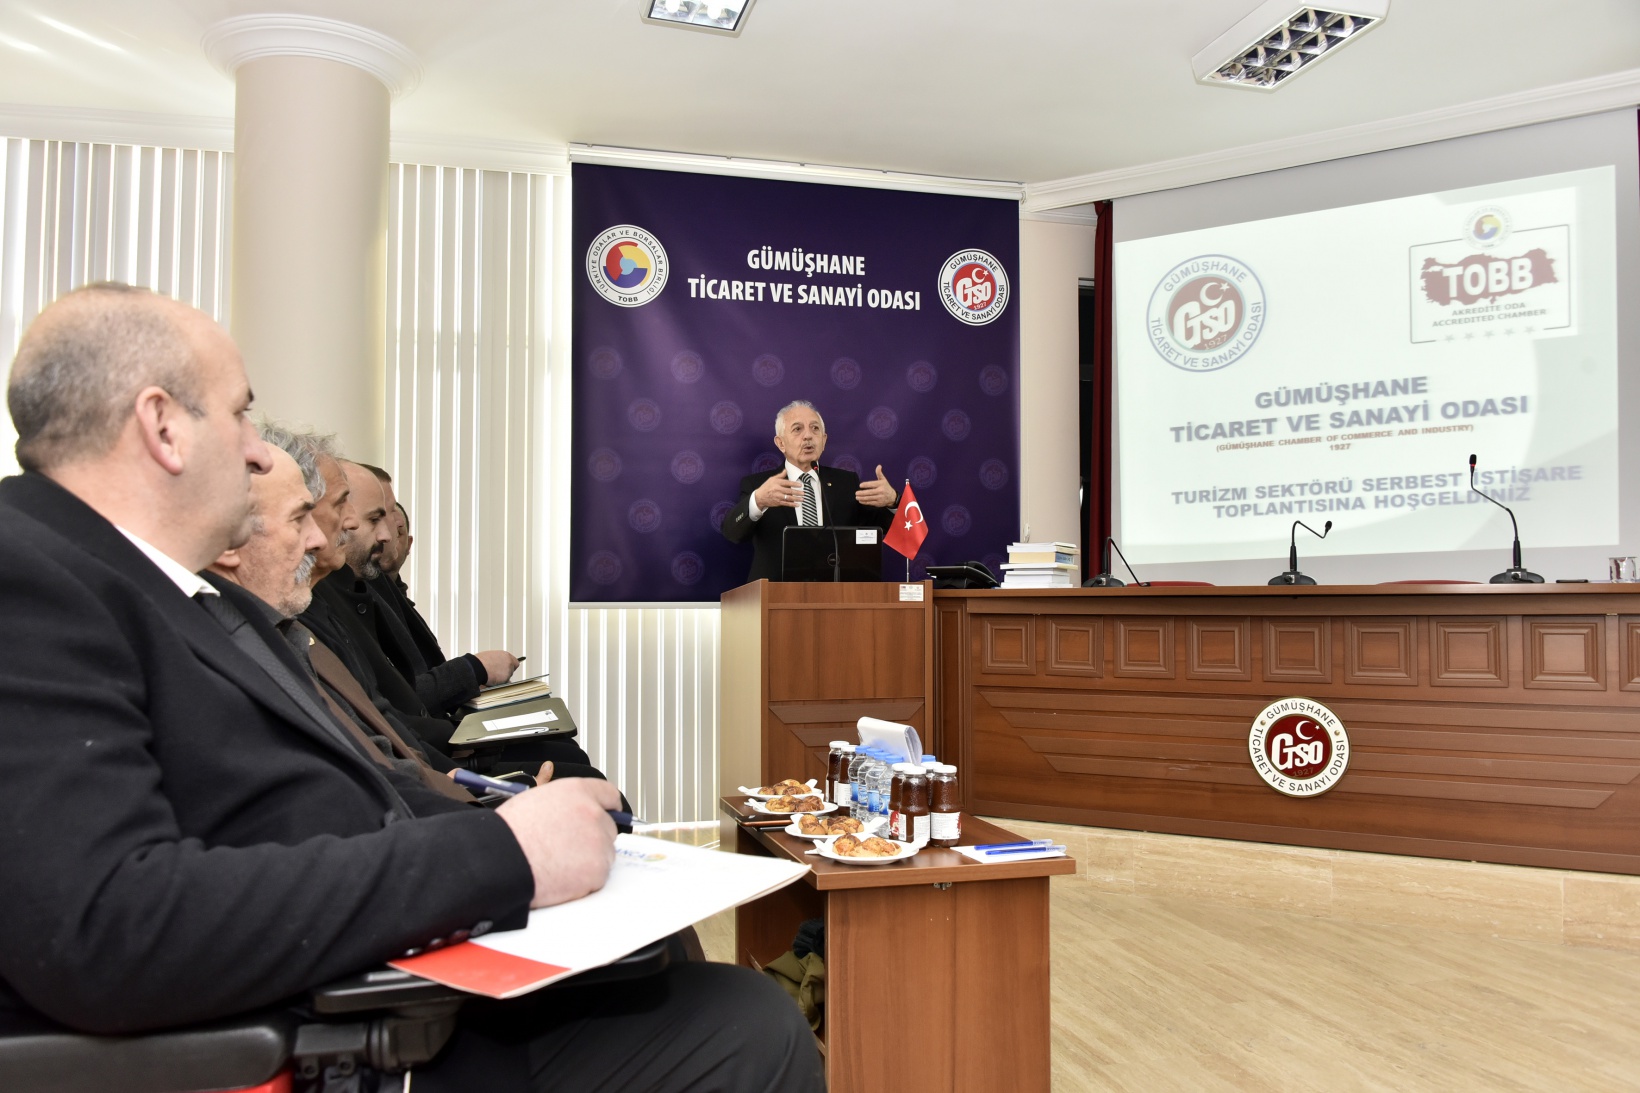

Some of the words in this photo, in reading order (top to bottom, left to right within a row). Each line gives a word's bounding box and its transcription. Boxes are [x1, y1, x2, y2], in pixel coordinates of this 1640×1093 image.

[592, 232, 617, 256] ODALAR
[633, 231, 663, 265] BORSALAR
[747, 245, 866, 277] GÜMÜŞHANE
[949, 253, 999, 273] GÜMÜŞHANE
[687, 274, 766, 302] TİCARET
[769, 283, 793, 303] VE
[797, 283, 863, 307] SANAYİ
[867, 289, 921, 310] ODASI
[1163, 260, 1247, 292] GÜMÜŞHANE
[1442, 257, 1533, 298] TOBB
[961, 309, 970, 319] VE
[994, 284, 1005, 308] ODASI
[973, 301, 987, 310] 1927
[1432, 314, 1495, 327] ACCREDITED
[1497, 308, 1547, 320] CHAMBER
[1504, 302, 1526, 310] ODA
[1151, 317, 1183, 362] TİCARET
[1183, 355, 1199, 367] VE
[1243, 301, 1262, 341] ODASI
[1204, 334, 1227, 350] 1927
[1254, 376, 1428, 409] GÜMÜŞHANE
[1170, 417, 1277, 443] TİCARET
[1286, 413, 1321, 433] VE
[1329, 400, 1430, 429] SANAYİ
[1440, 395, 1529, 420] ODASI
[1278, 436, 1322, 447] CHAMBER
[1326, 434, 1338, 442] OF
[1341, 430, 1393, 441] COMMERCE
[1397, 428, 1418, 437] AND
[1421, 424, 1474, 434] INDUSTRY)
[1329, 443, 1351, 451] 1927
[1171, 486, 1247, 505] TURİZM
[1255, 477, 1353, 500] SEKTÖRÜ
[1362, 473, 1463, 492] SERBEST
[1473, 465, 1582, 487] İSTİŞARE
[1213, 496, 1366, 519] TOPLANTISINA
[1374, 484, 1531, 511] HOŞGELDİNİZ
[1266, 699, 1336, 728] GÜMÜŞHANE
[1252, 728, 1273, 776] TİCARET
[1272, 774, 1287, 788] VE
[1288, 773, 1331, 792] SANAYİ
[1329, 740, 1346, 776] ODASI
[1292, 767, 1314, 777] 1927
